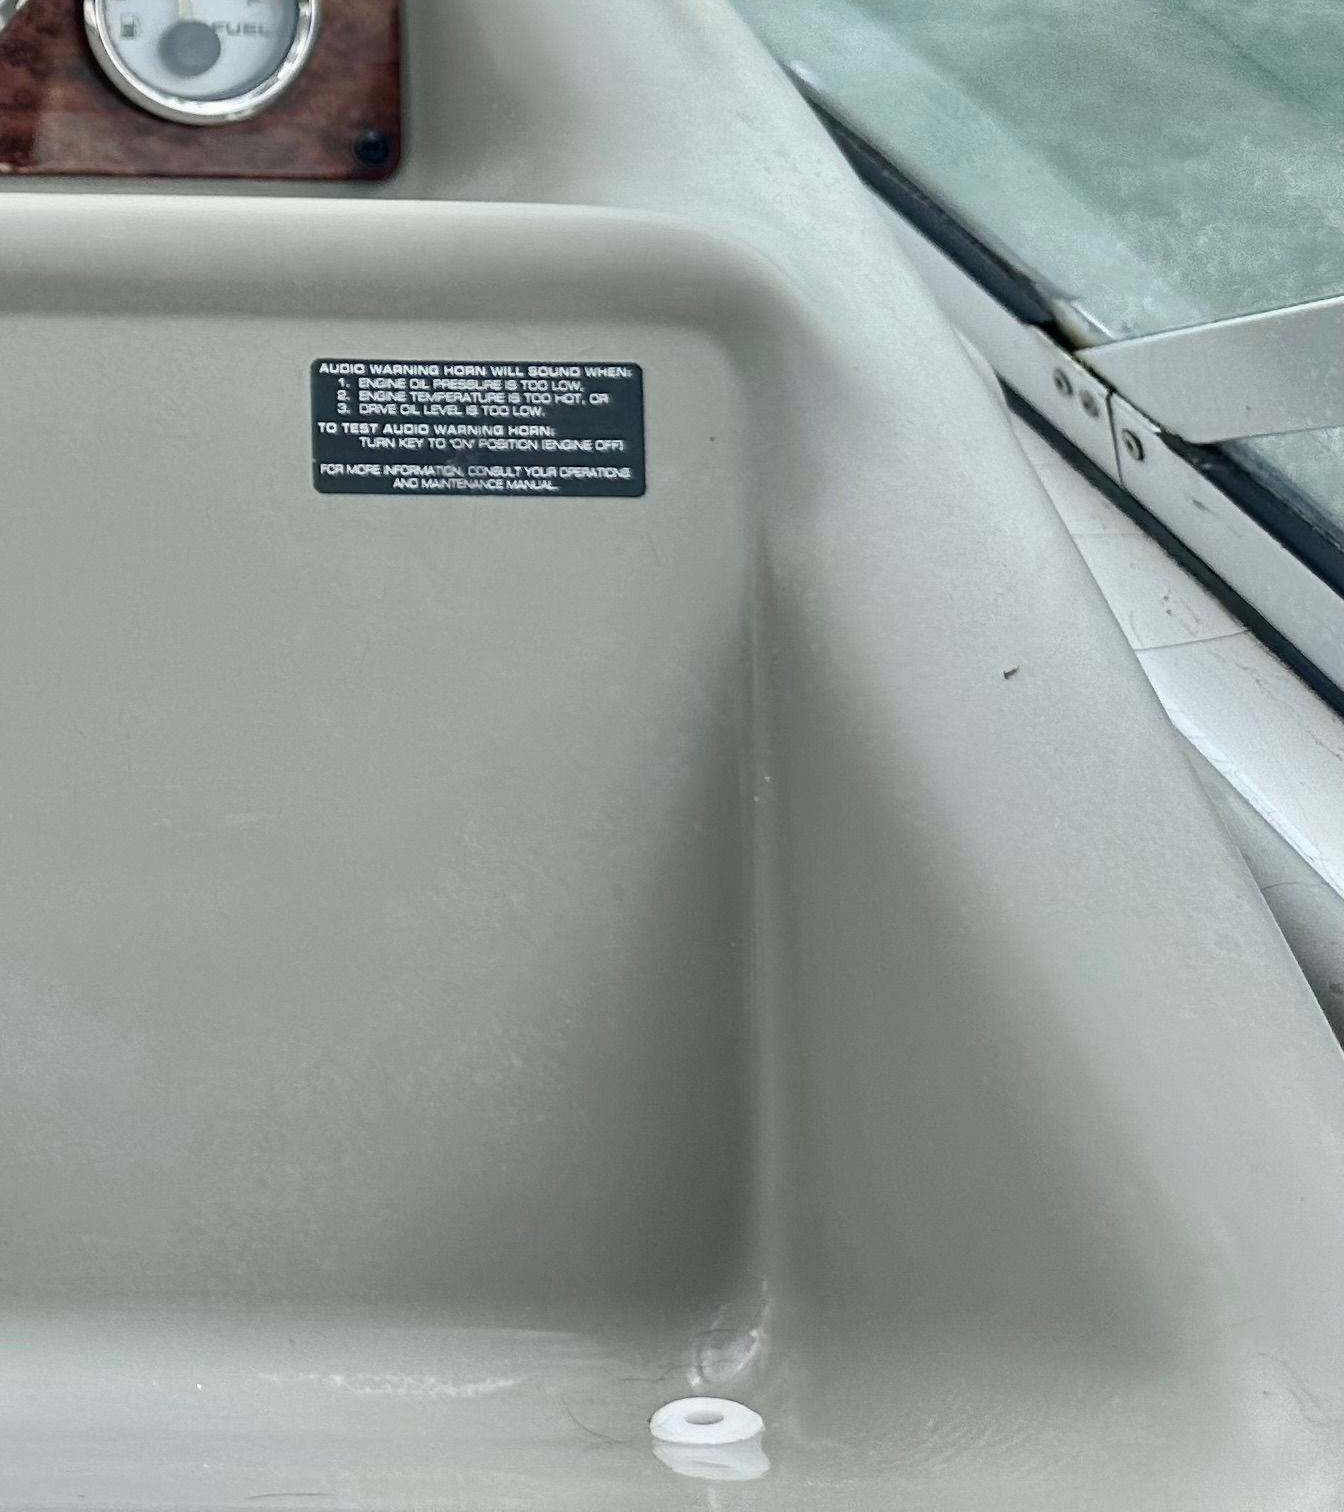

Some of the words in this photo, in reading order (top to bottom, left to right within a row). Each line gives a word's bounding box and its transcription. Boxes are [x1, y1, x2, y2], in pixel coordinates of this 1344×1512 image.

[211, 21, 274, 37] FUEL
[319, 363, 365, 374] AUDIO
[370, 364, 440, 376] WARNING
[444, 365, 486, 376] HORN
[490, 365, 524, 377] WILL
[527, 366, 581, 378] SOUND
[584, 366, 632, 378] WHEN:
[337, 377, 351, 388] 1.
[358, 377, 406, 389] ENGINE
[409, 378, 430, 389] OIL
[433, 378, 503, 390] PRESSURE
[505, 379, 518, 390] IS
[520, 379, 548, 391] TOO
[337, 390, 351, 401] 2.
[358, 390, 407, 402] ENGINE
[410, 391, 506, 403] TEMPERATURE
[509, 393, 521, 404] IS
[524, 393, 551, 404] TOO
[589, 393, 609, 404] OR
[337, 402, 351, 414] 3.
[359, 403, 397, 414] DRIVE
[400, 404, 420, 415] OIL
[423, 404, 463, 416] LEVEL
[466, 405, 478, 416] IS
[481, 405, 509, 417] TOO
[318, 422, 337, 433] TO
[341, 422, 379, 434] TEST
[383, 423, 429, 435] AUDIO
[433, 424, 504, 436] WARNING
[508, 425, 556, 437] HORN:
[359, 437, 395, 448] TURN
[399, 437, 424, 448] KEY
[428, 438, 446, 449] TO
[478, 439, 538, 450] POSITION
[320, 464, 344, 475] FOR
[346, 464, 381, 476] MORE
[468, 466, 522, 478] CONSULT
[524, 466, 558, 478] YOUR
[393, 478, 419, 489] AND
[421, 478, 504, 489] MAINTENANCE
